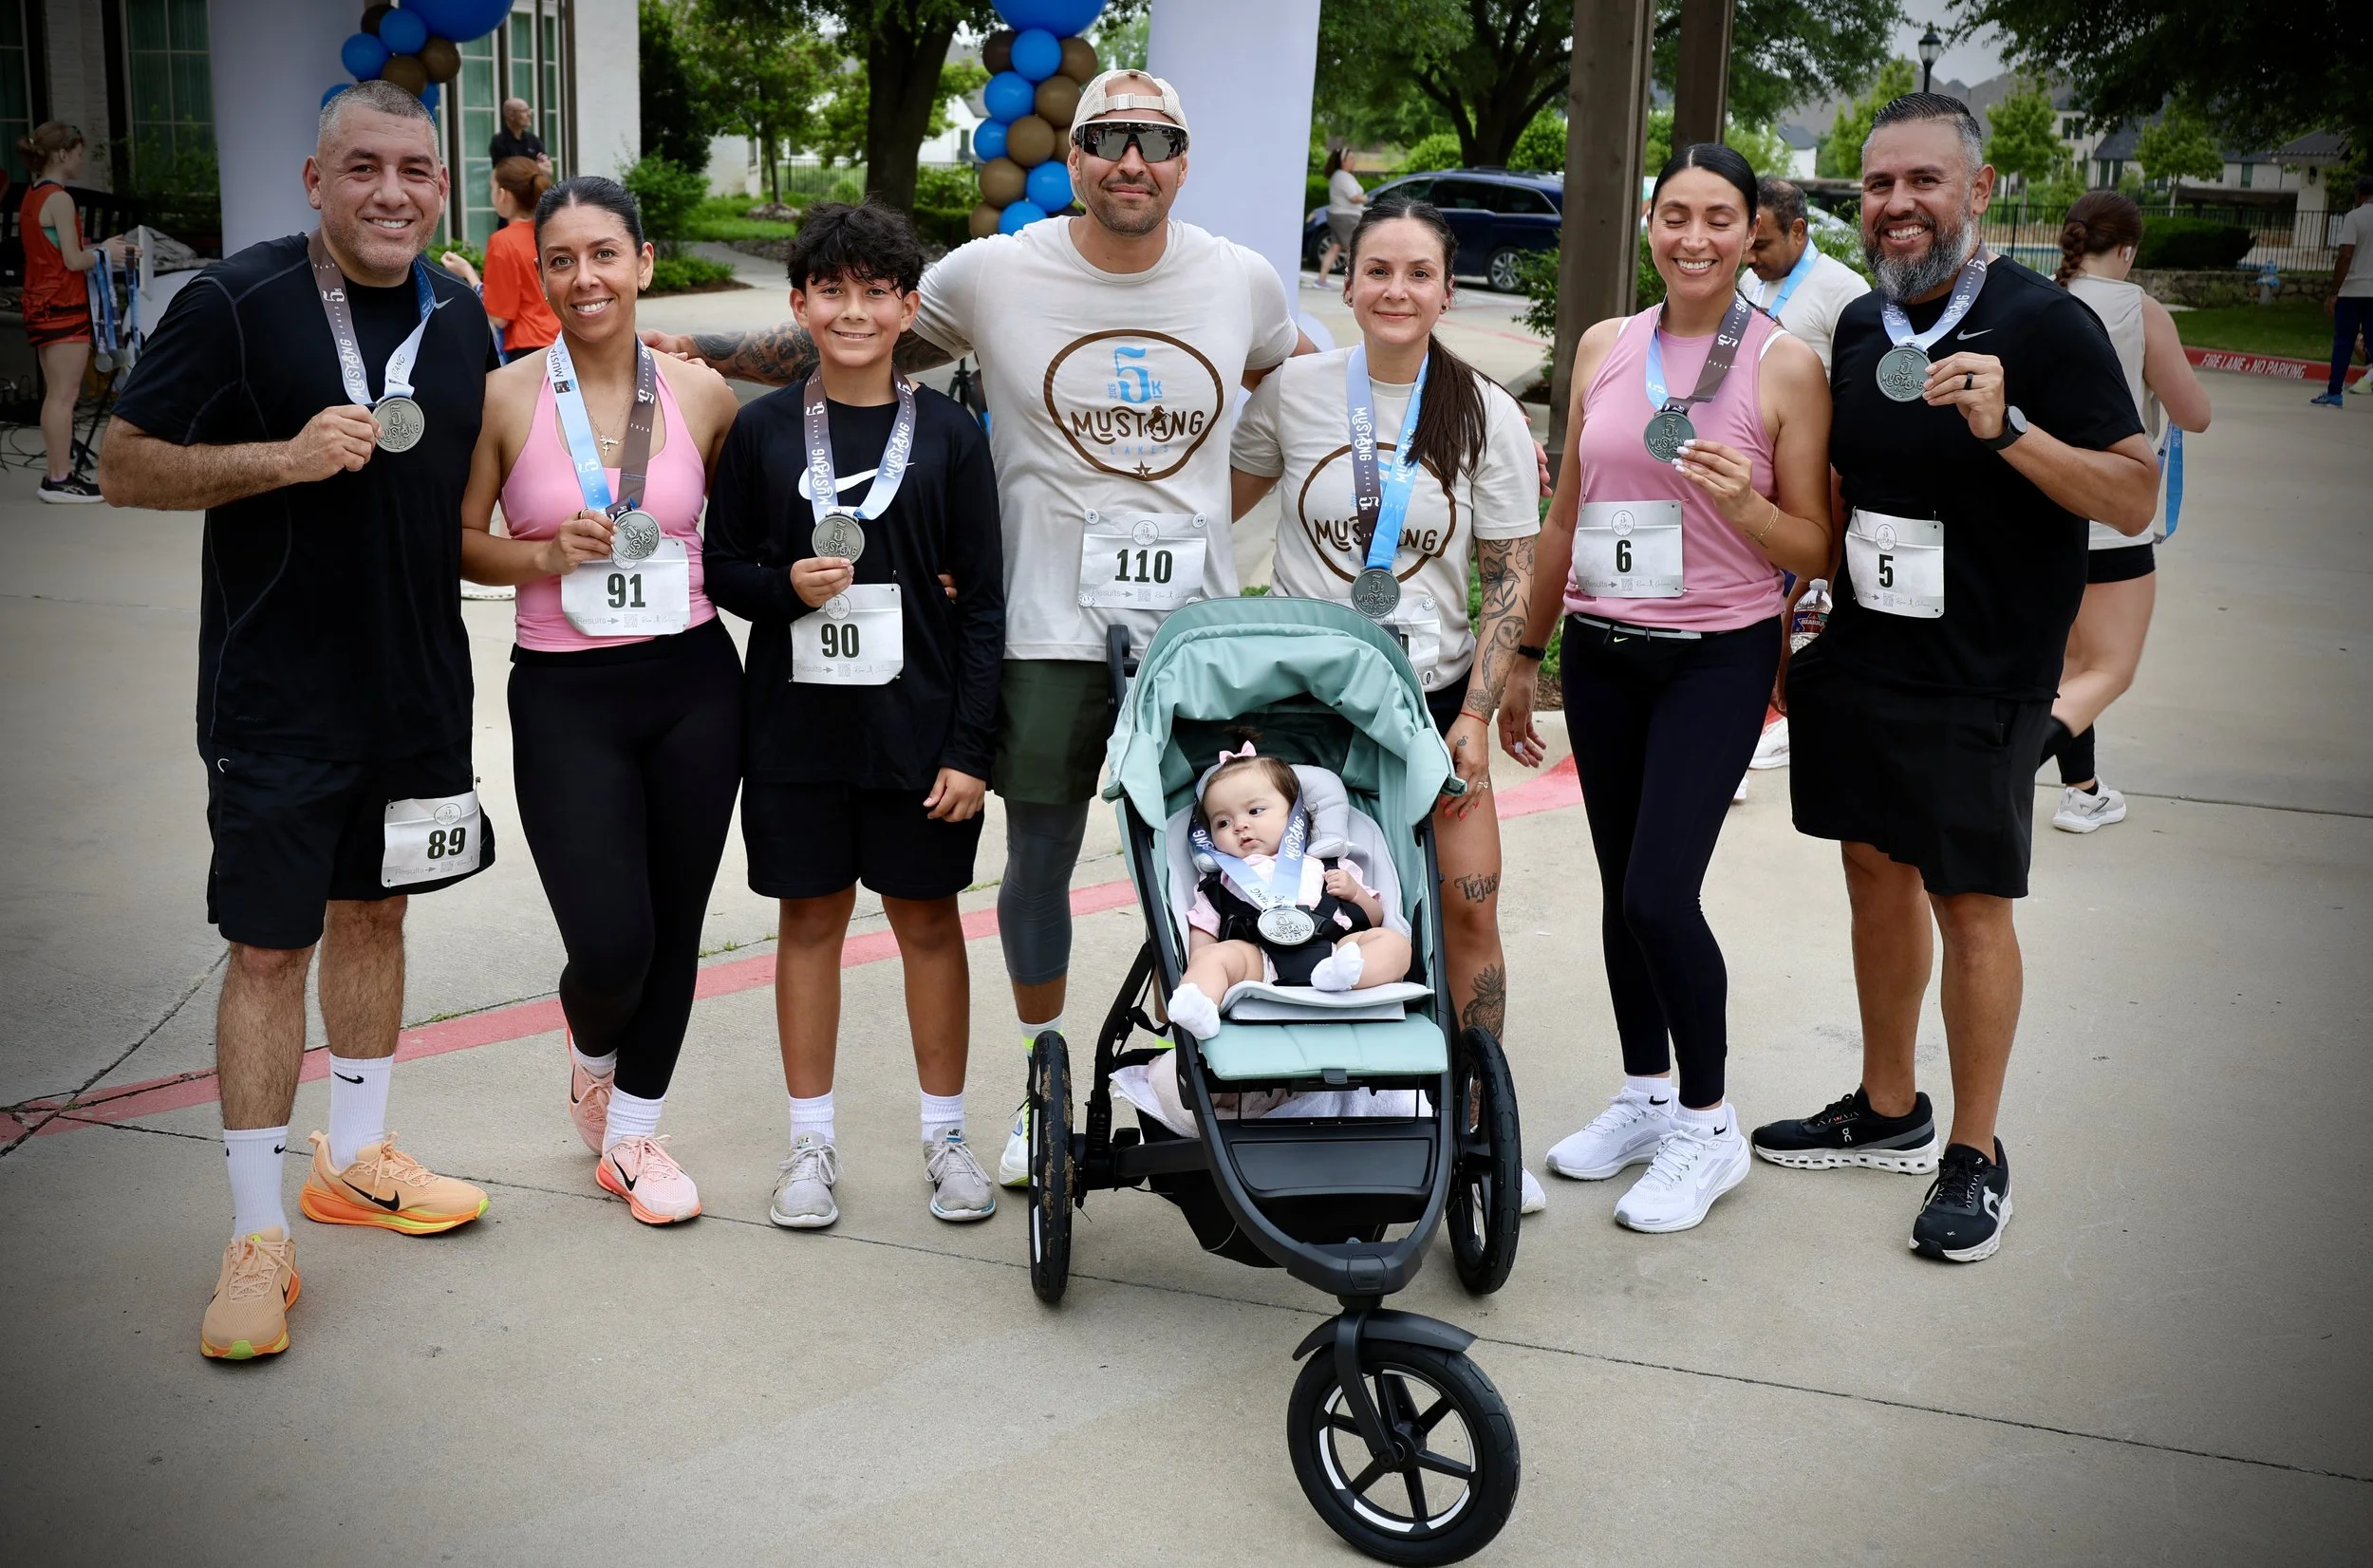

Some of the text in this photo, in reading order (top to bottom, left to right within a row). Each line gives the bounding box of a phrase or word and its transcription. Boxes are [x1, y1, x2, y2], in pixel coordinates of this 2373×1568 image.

[339, 338, 365, 398] MUSTANG
[2200, 353, 2307, 380] FIRE LANE NO PARKING
[382, 423, 419, 442] USTANG
[1070, 405, 1205, 445] MUSTANG
[1352, 407, 1373, 461] MUSTANG
[884, 422, 910, 479] MUSTANG
[1110, 443, 1170, 457] LAKES
[812, 448, 833, 506] MUSTANG
[623, 524, 658, 558] MUSTANG
[816, 539, 858, 556] MUSTANG
[1314, 515, 1438, 552] MUSNG
[1114, 549, 1173, 584] 110
[1616, 539, 1632, 573] 6
[1879, 553, 1894, 588] 5
[607, 573, 646, 608] 91
[1092, 588, 1121, 597] Results
[1356, 593, 1395, 607] MUSTANG
[821, 624, 860, 658] 90
[427, 827, 466, 860] 89
[1284, 815, 1305, 862] MUSTANG
[1454, 871, 1499, 903] Tejas
